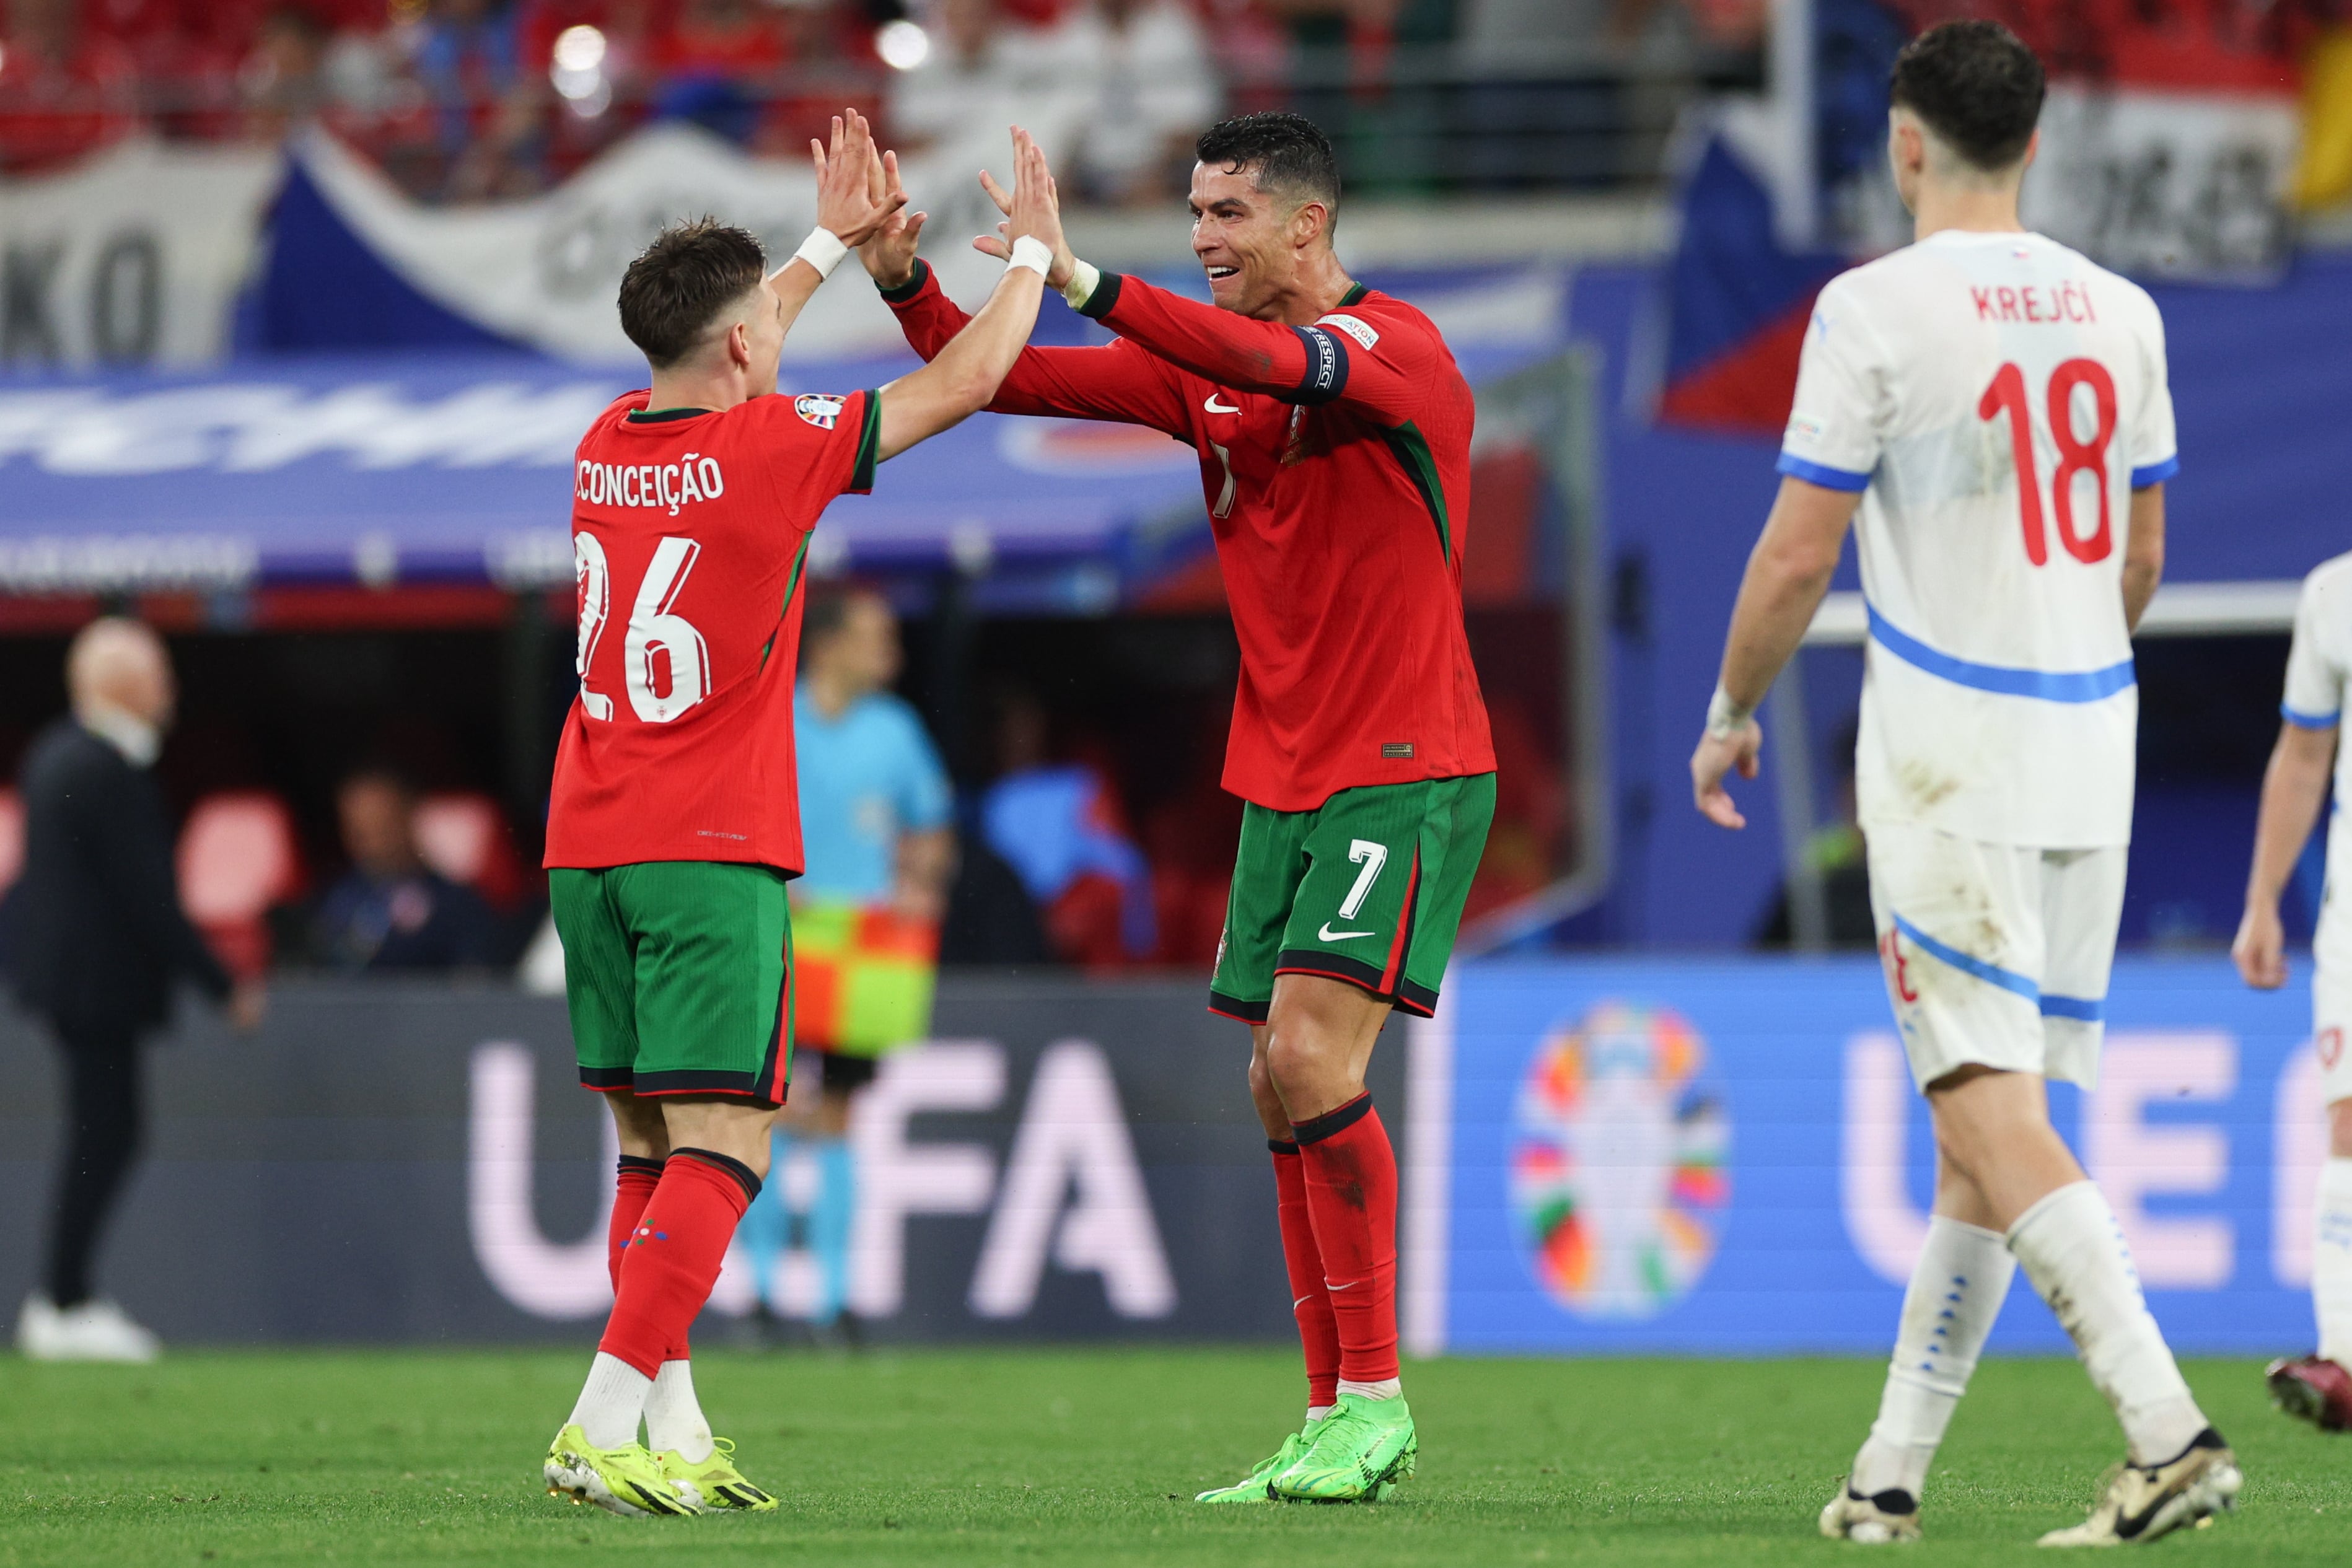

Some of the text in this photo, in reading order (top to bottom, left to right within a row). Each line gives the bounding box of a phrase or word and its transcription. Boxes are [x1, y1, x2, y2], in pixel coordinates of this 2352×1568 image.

[1970, 279, 2097, 323] KREJČÍ
[1315, 334, 1333, 389] RESPECT
[1978, 357, 2117, 566] 18
[574, 531, 711, 723] 26
[1348, 839, 1388, 920] 7
